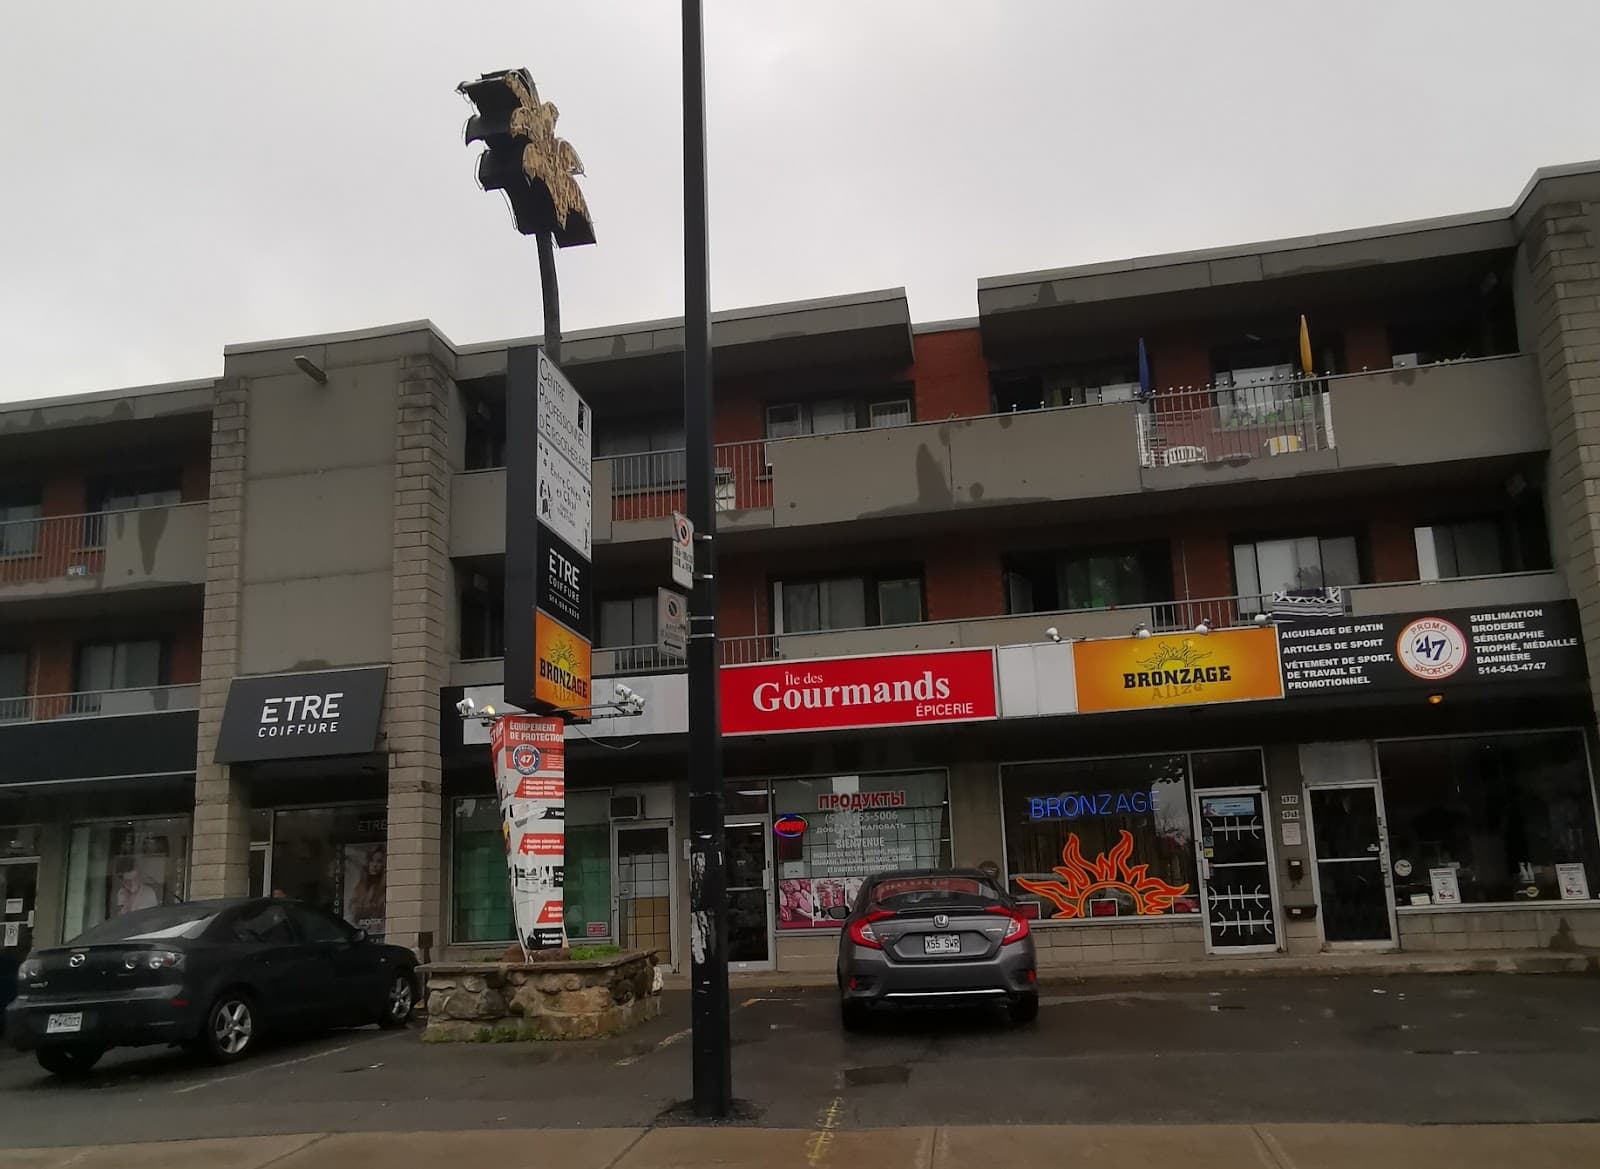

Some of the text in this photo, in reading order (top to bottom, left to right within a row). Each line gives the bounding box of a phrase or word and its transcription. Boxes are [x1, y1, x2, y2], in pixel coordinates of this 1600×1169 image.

[549, 547, 580, 591] ETRE
[549, 574, 580, 603] COIFFURE
[1470, 609, 1543, 622] SUBLIMATION
[1281, 623, 1384, 640] AIGUISAGE DE PATIN
[1411, 621, 1448, 635] PROMO
[1472, 621, 1526, 633] BRODERIE
[1283, 639, 1384, 654] ARTICLES DE SPORT
[1415, 635, 1447, 661] 47
[1342, 656, 1357, 665] DE
[1357, 653, 1394, 663] SPORT,
[1287, 666, 1363, 679] DE TRAVAIL ET
[1414, 662, 1454, 676] SPORTS
[1478, 662, 1547, 675] 514-543-4747
[540, 657, 588, 699] BRONZAGE
[785, 671, 824, 686] Île des
[1123, 666, 1232, 689] BRONZAGE
[1288, 676, 1371, 690] PROMOTIONNEL
[753, 671, 951, 712] Gourmands
[260, 692, 344, 724] ETRE
[916, 703, 974, 717] ÉPICERIE
[258, 721, 339, 738] COIFFURE
[510, 732, 520, 740] DE
[520, 754, 533, 764] 47
[818, 791, 905, 810] ПРОДУКТЫ
[1030, 790, 1161, 819] BRONZAGE
[836, 836, 885, 849] BIENVENUE
